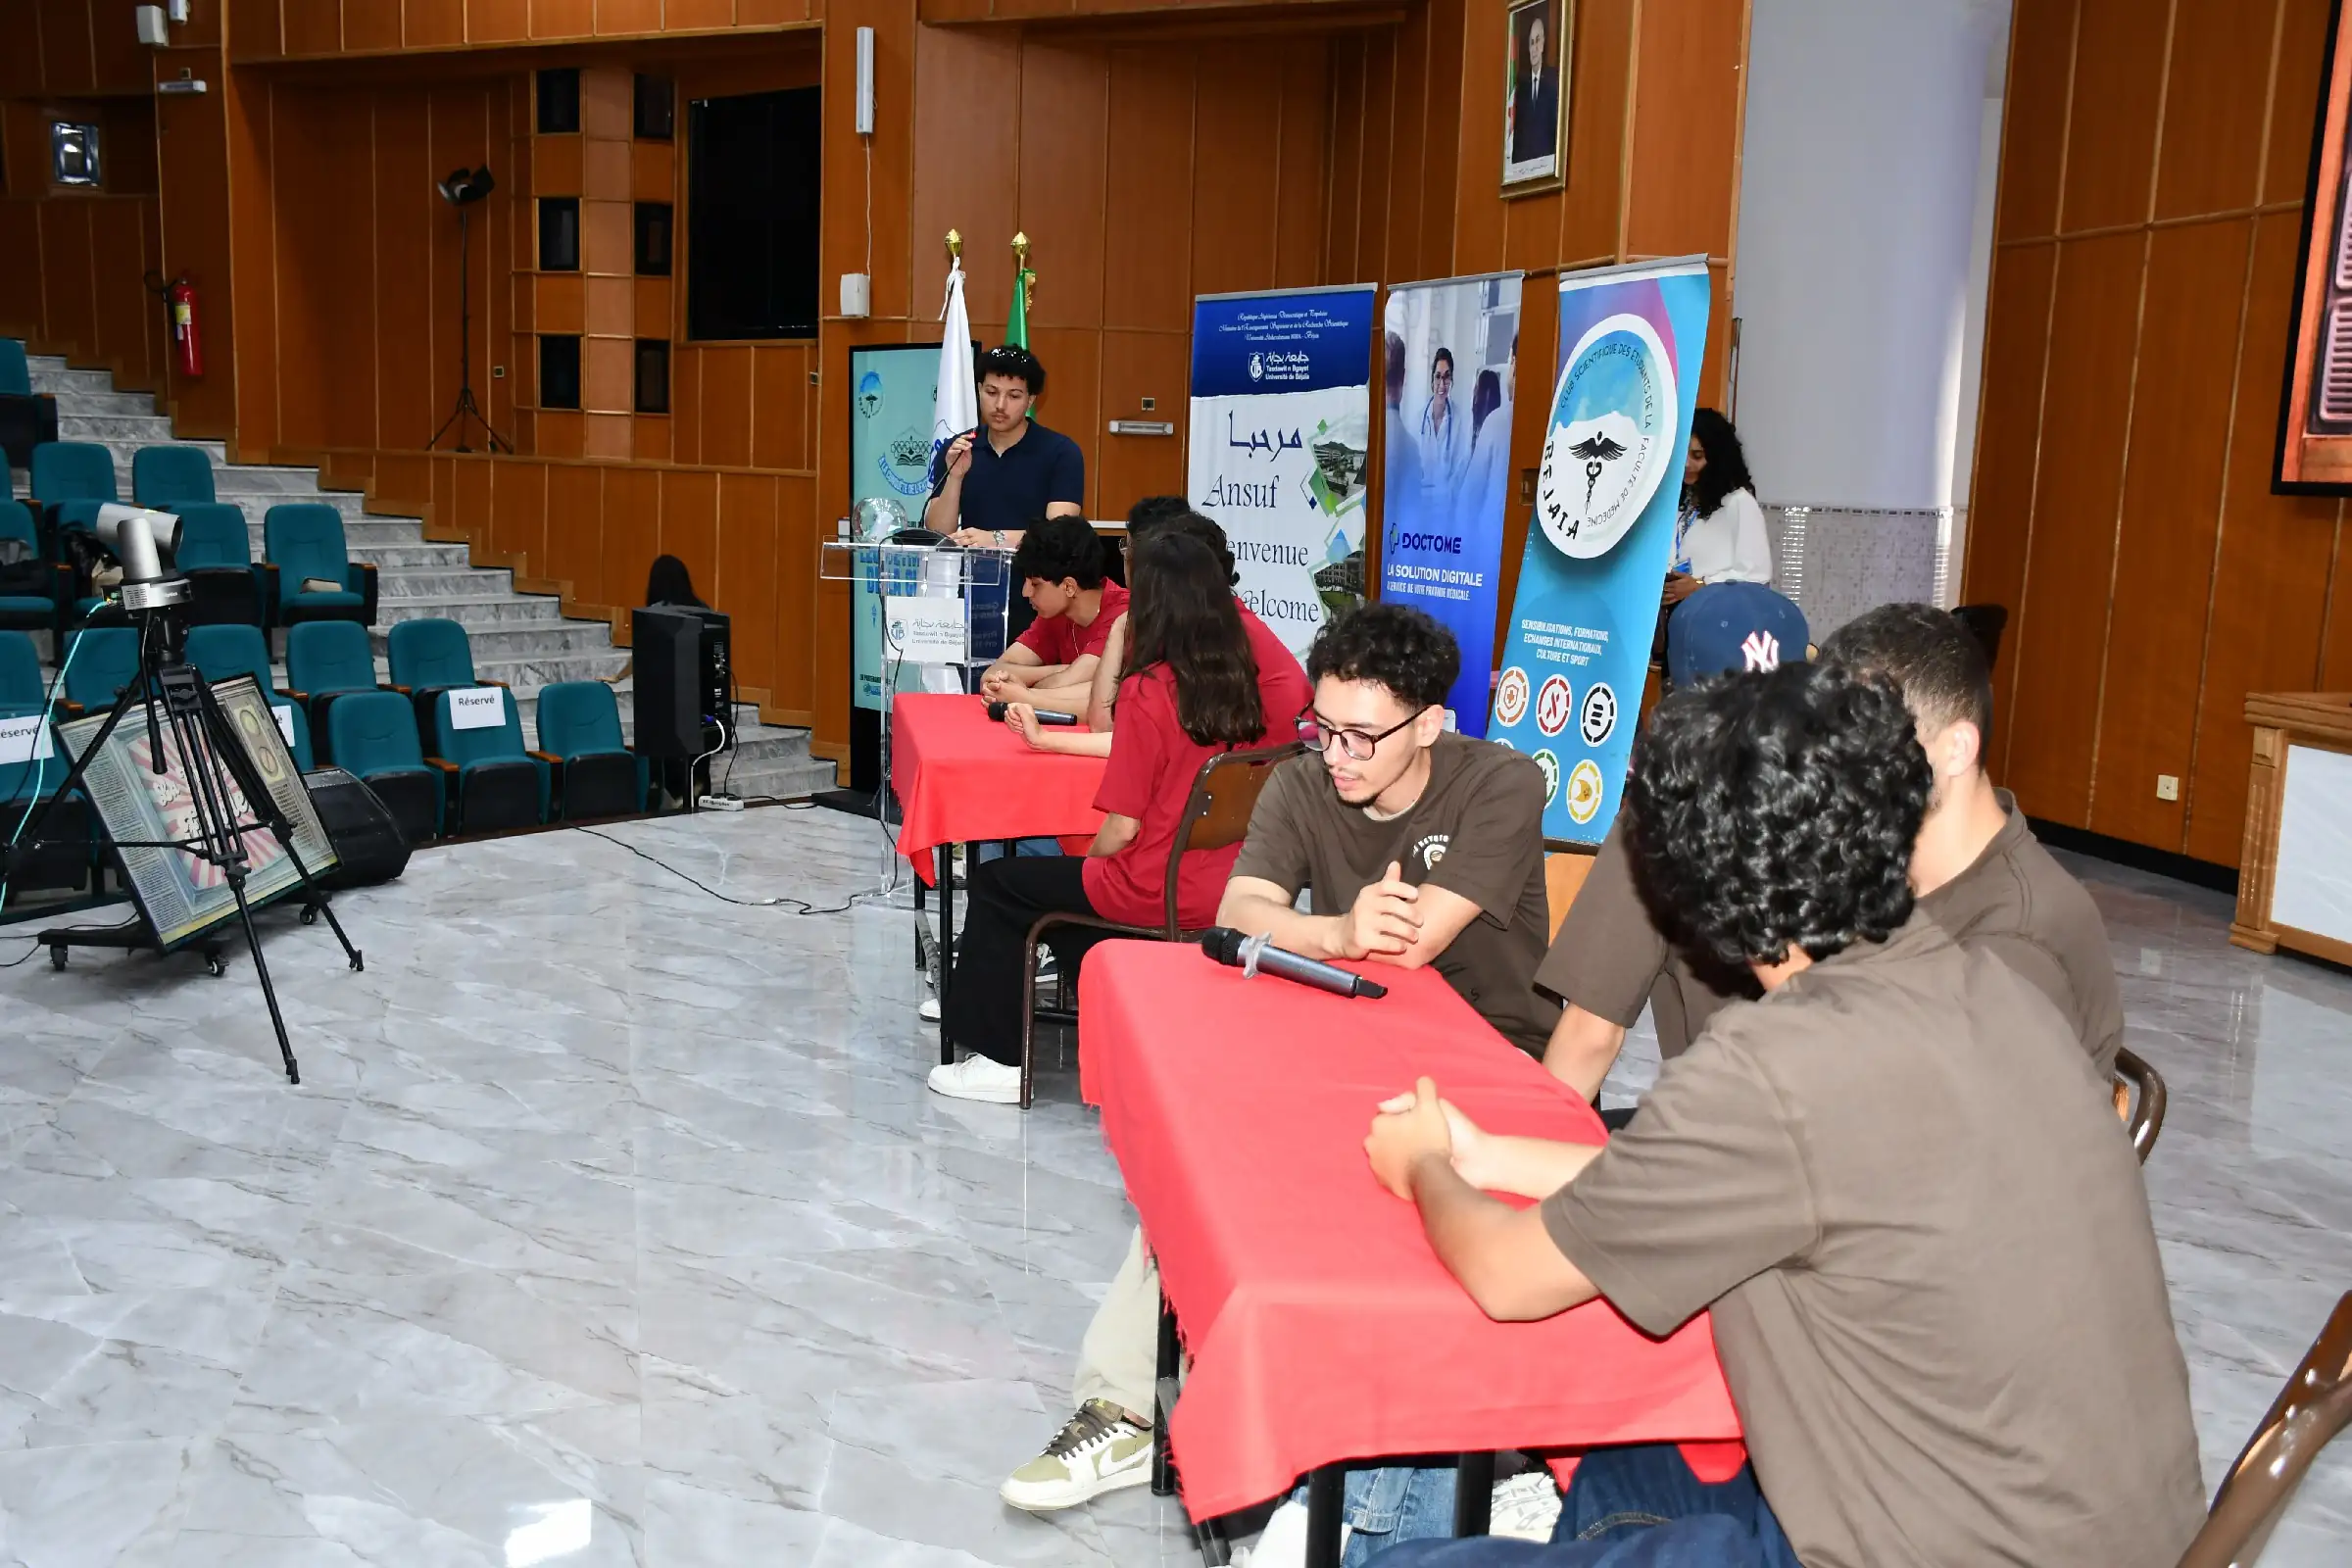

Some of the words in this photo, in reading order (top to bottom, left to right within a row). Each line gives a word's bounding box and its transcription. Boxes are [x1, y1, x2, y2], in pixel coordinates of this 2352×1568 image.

[1618, 344, 1631, 357] DES
[1228, 410, 1302, 463] مرحبا
[1201, 473, 1280, 509] Ansuf
[1227, 540, 1309, 566] envenue
[1402, 532, 1461, 554] DOCTOME
[1396, 564, 1440, 582] SOLUTION
[1442, 569, 1483, 586] DIGITALE
[1537, 648, 1561, 662] CULTURE
[1561, 653, 1571, 662] ET
[1570, 655, 1590, 666] SPORT
[459, 694, 495, 706] Réservé
